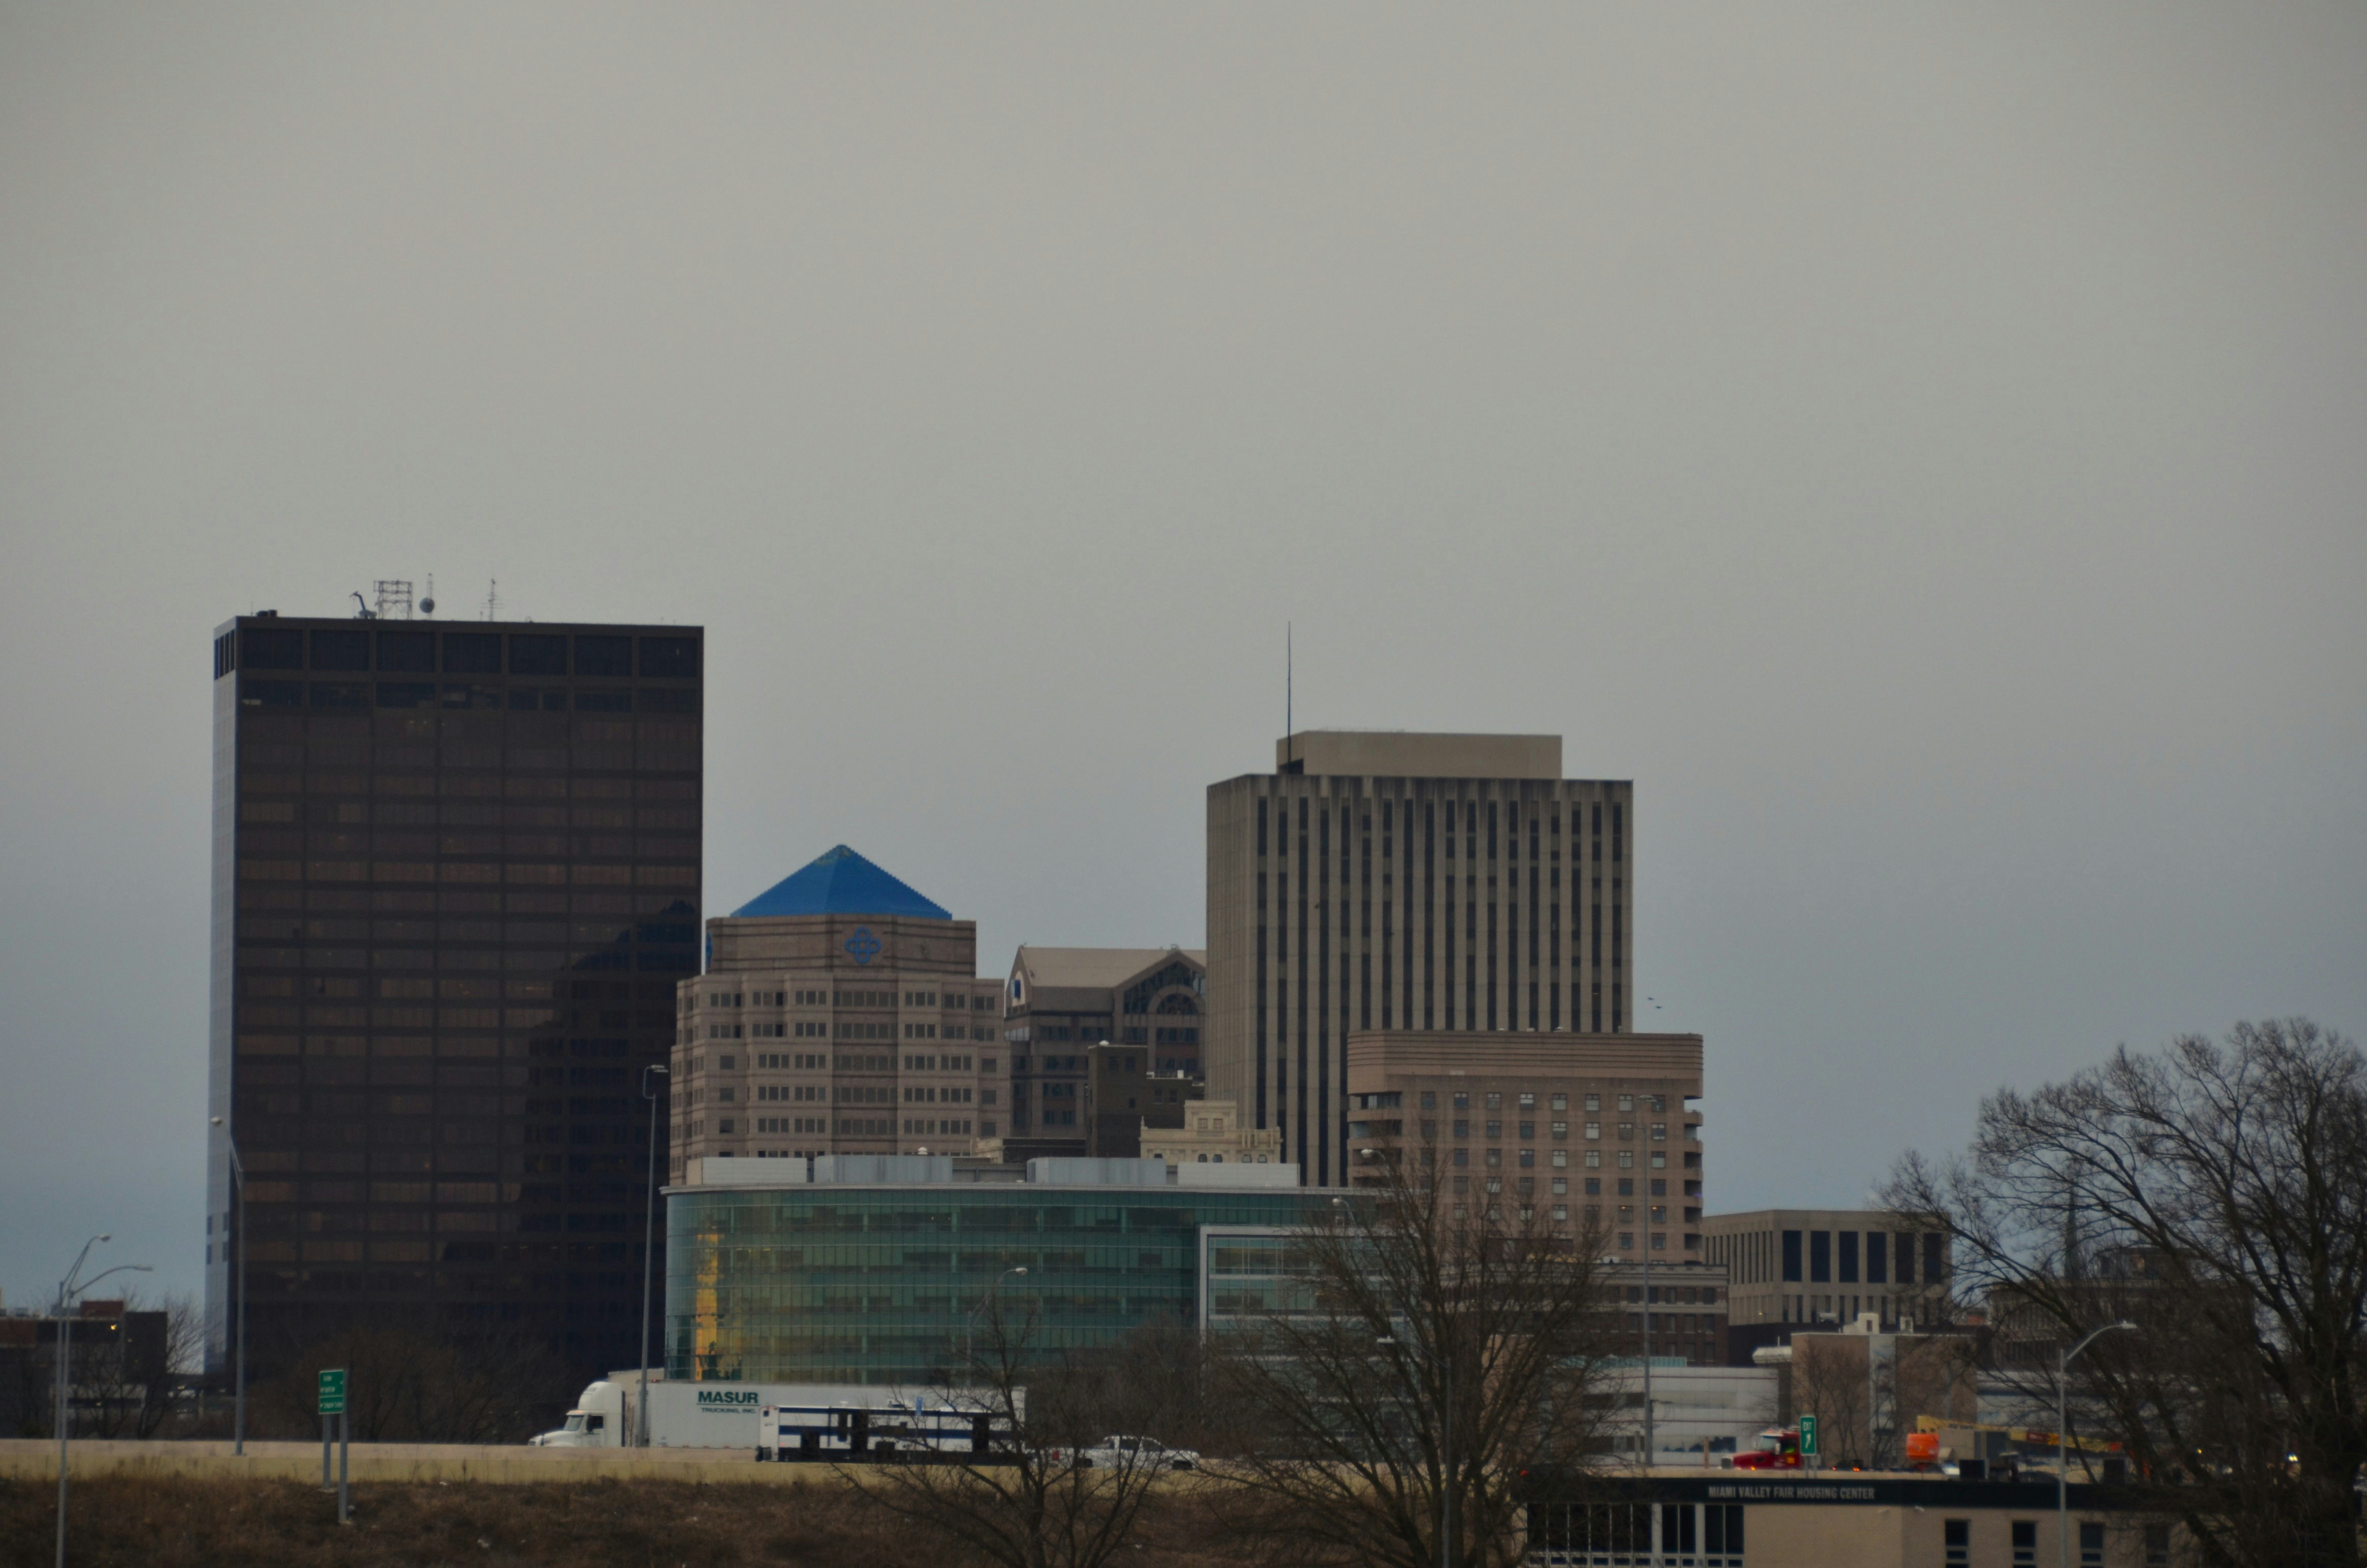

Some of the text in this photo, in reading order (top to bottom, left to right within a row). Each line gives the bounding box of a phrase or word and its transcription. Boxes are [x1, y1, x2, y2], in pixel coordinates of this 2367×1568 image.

[698, 1391, 758, 1403] MASUR
[1708, 1486, 1875, 1500] MIAMI VALLEY FAIR HOUSING CENTER
